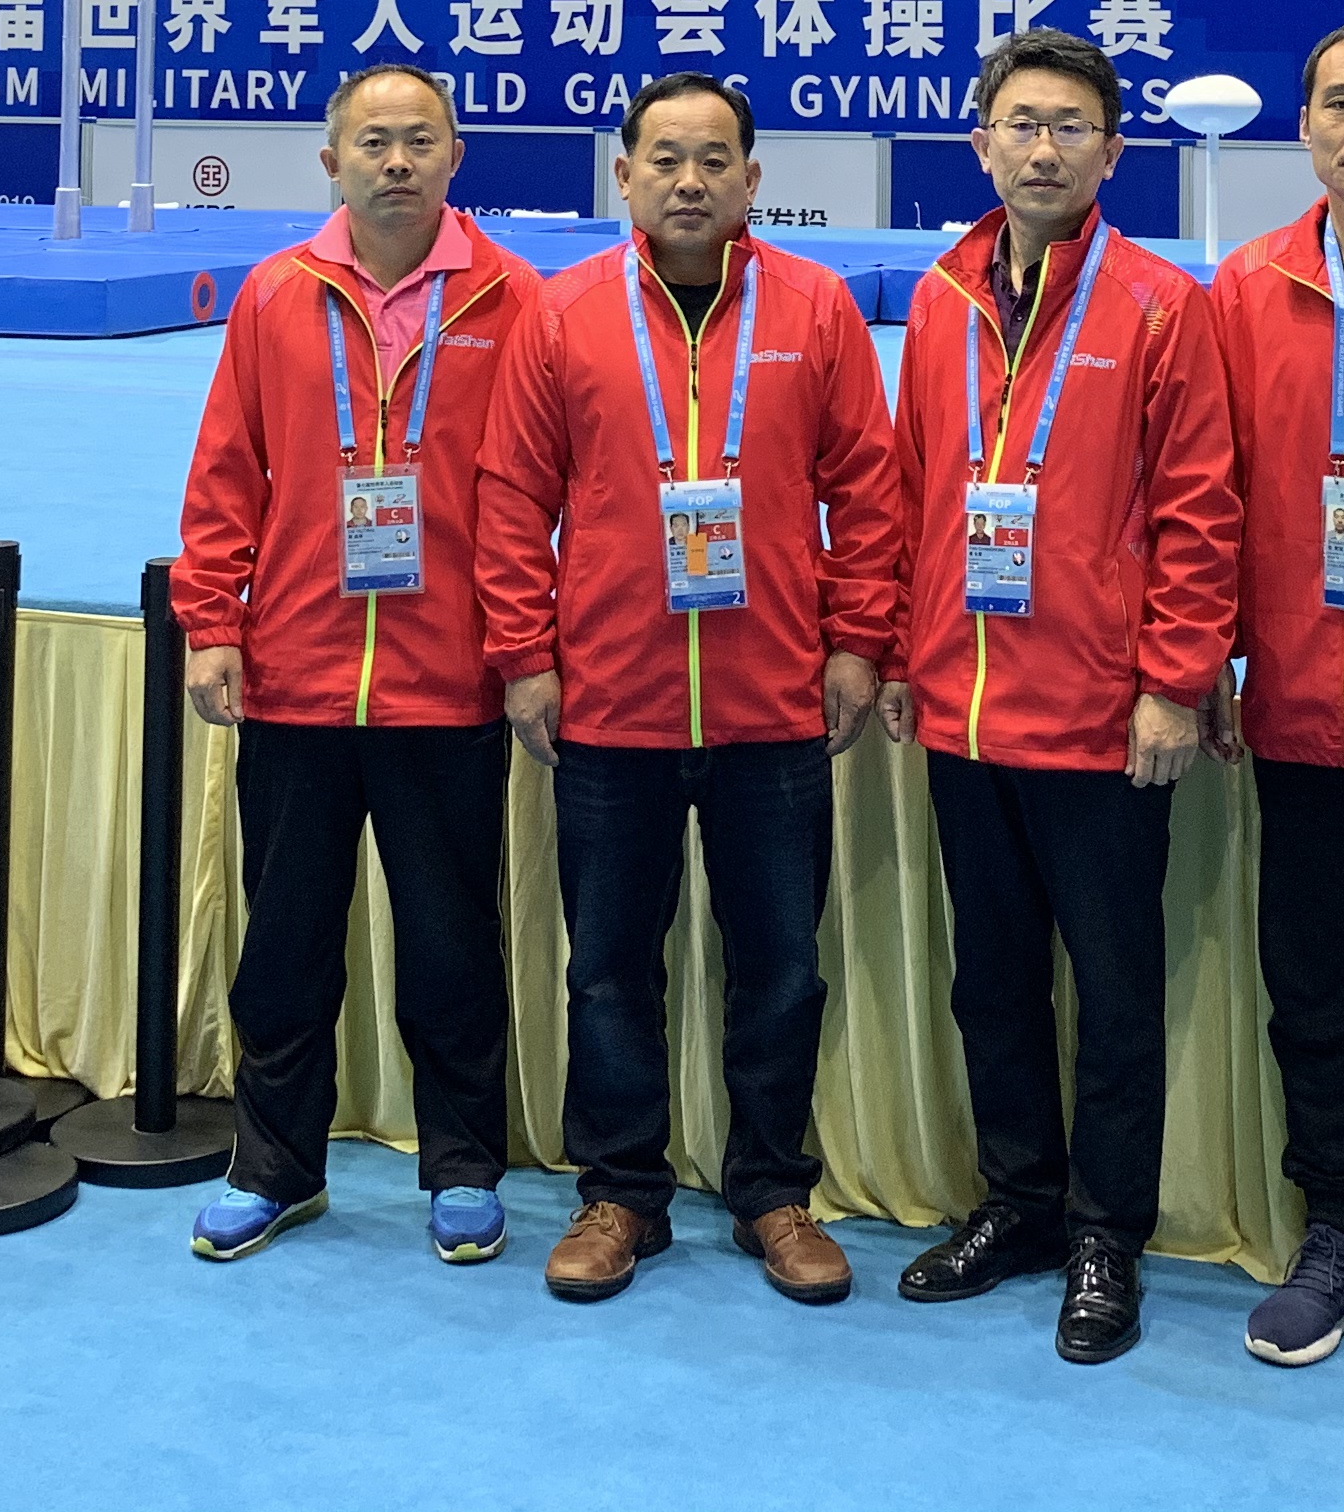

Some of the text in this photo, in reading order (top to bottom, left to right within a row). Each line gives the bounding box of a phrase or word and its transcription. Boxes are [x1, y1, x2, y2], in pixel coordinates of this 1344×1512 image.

[80, 68, 307, 110] MIITARY
[688, 496, 713, 506] FOP
[989, 499, 1011, 509] FOP
[391, 509, 398, 518] C
[713, 525, 721, 535] C
[1008, 530, 1015, 540] C
[407, 574, 415, 586] 2
[733, 592, 740, 604] 2
[1018, 600, 1026, 613] 2
